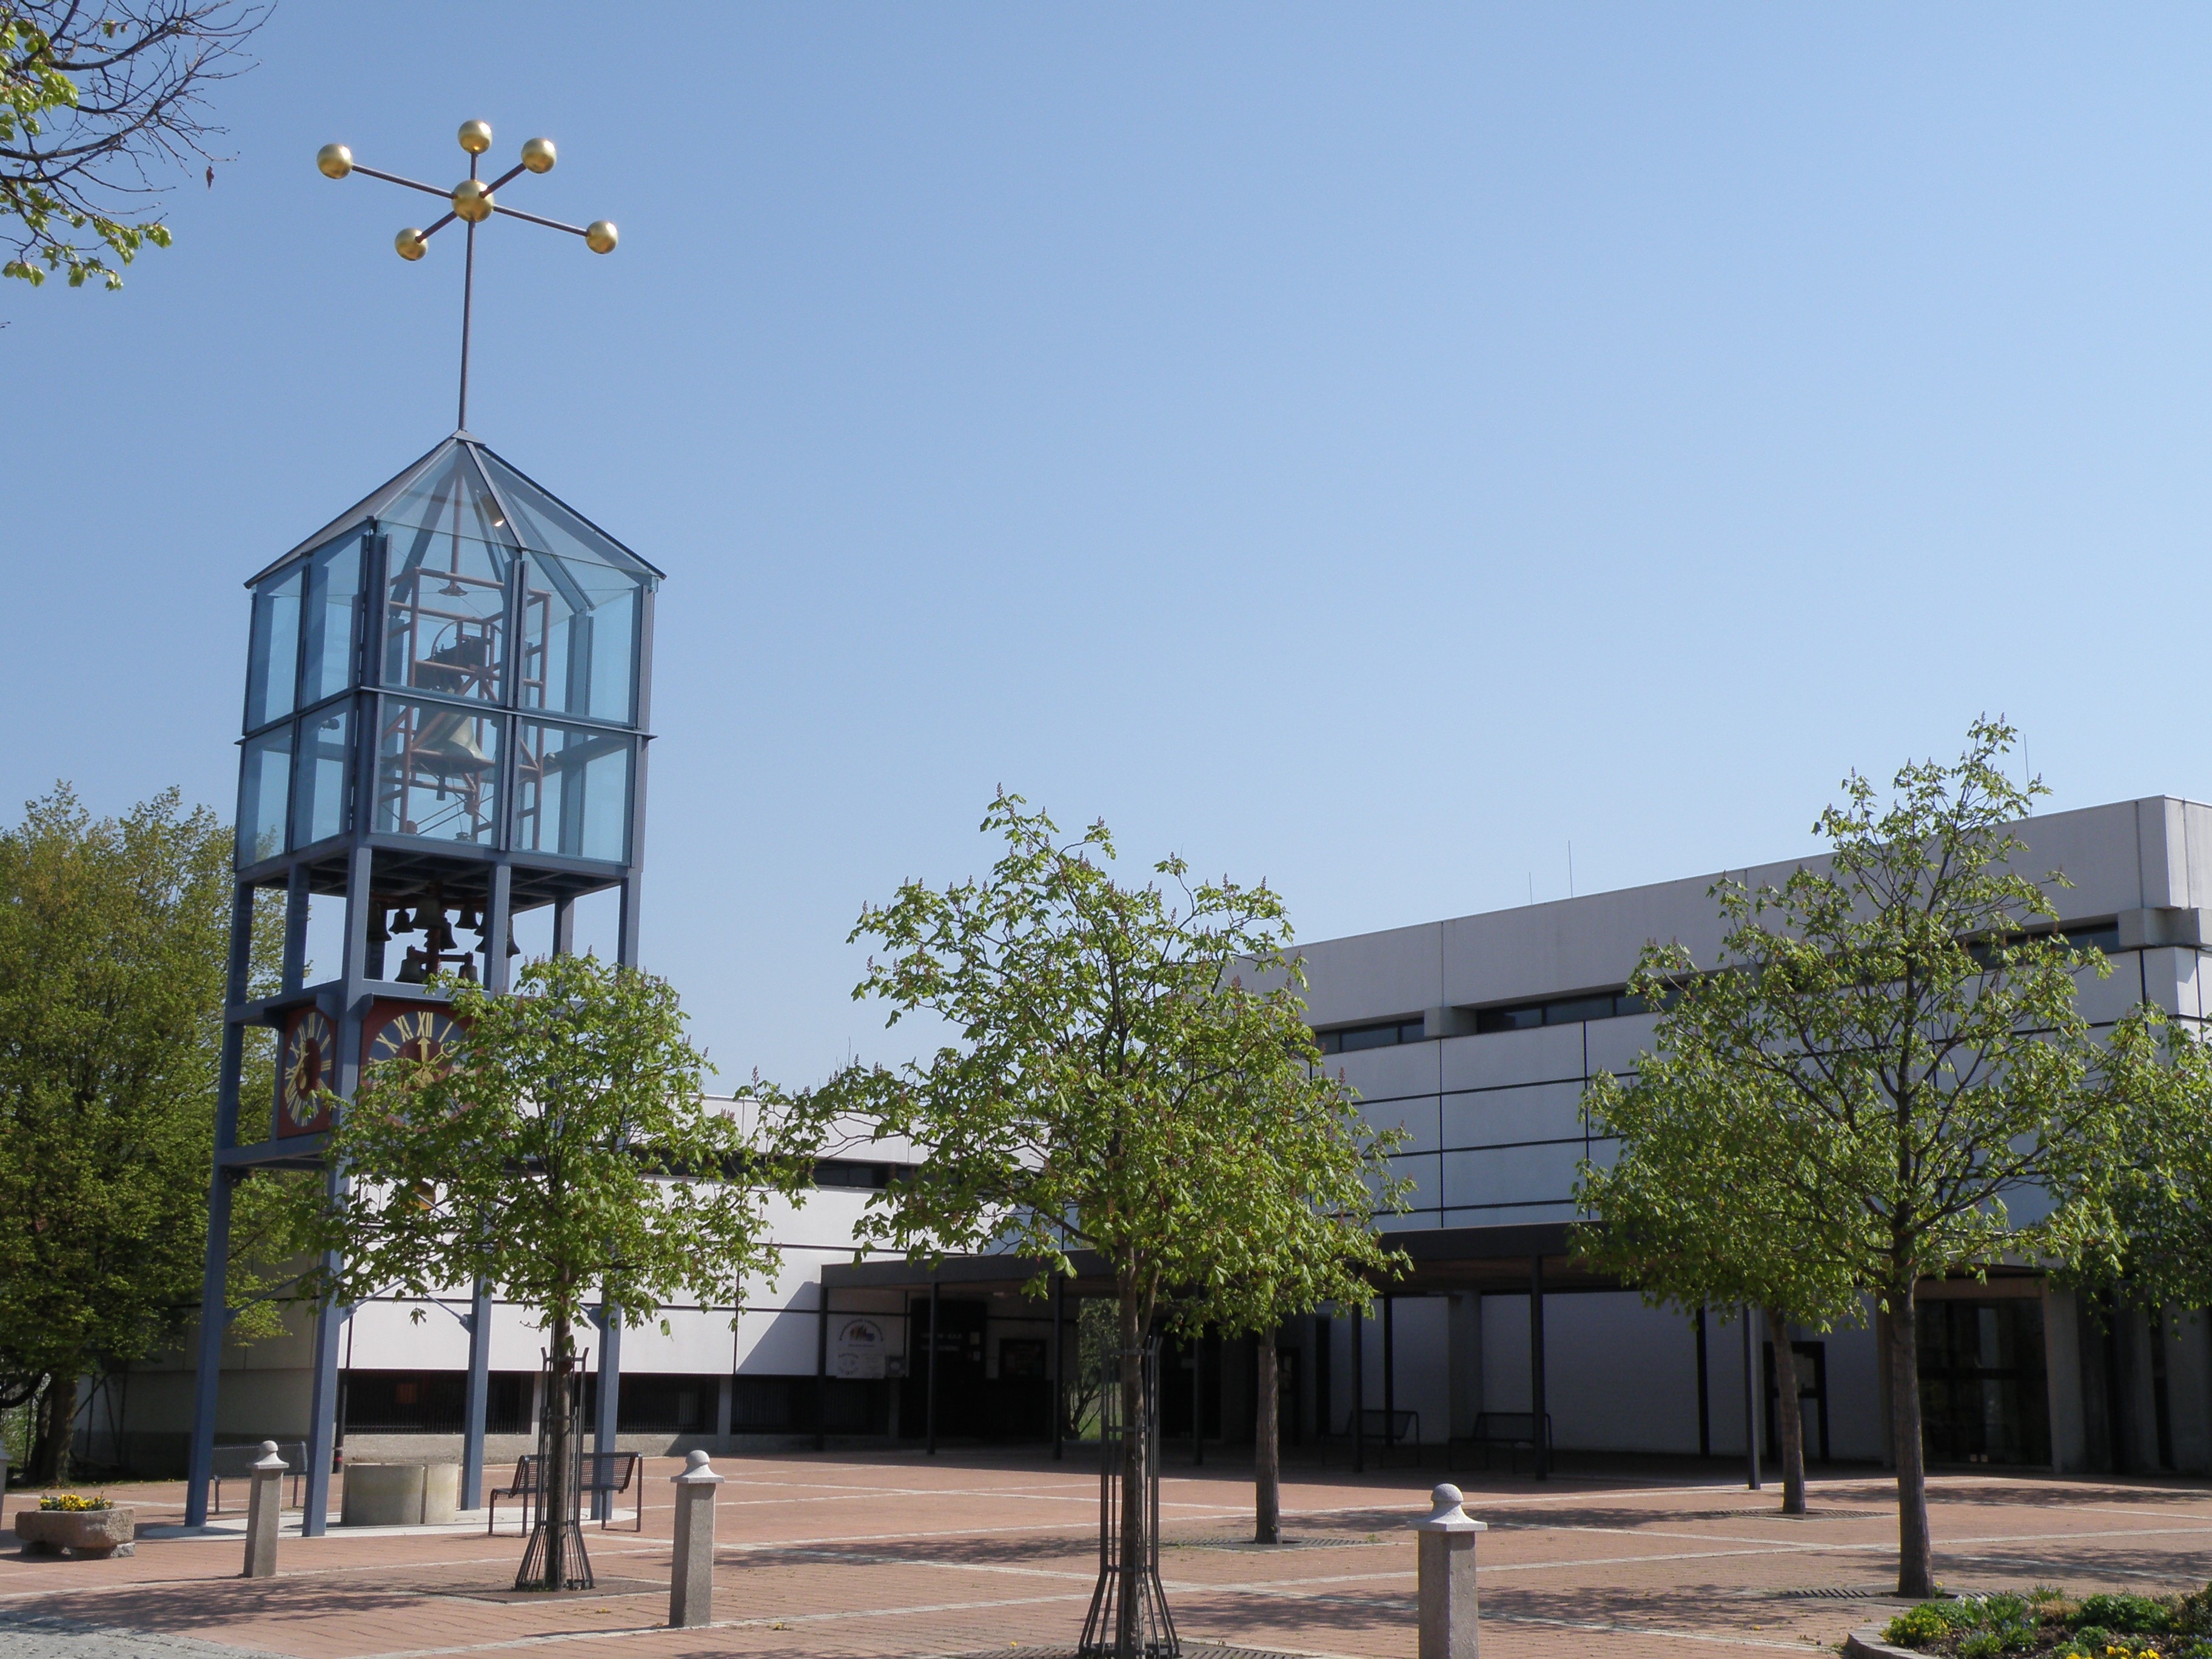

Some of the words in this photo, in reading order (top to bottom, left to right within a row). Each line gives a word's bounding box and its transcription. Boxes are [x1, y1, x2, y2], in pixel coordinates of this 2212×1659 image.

[316, 1017, 324, 1041] I
[393, 1014, 414, 1043] XI
[417, 1011, 434, 1038] XII
[438, 1021, 454, 1043] I
[289, 1041, 300, 1059] X
[320, 1034, 331, 1053] II
[375, 1032, 400, 1054] X
[320, 1059, 332, 1072] III
